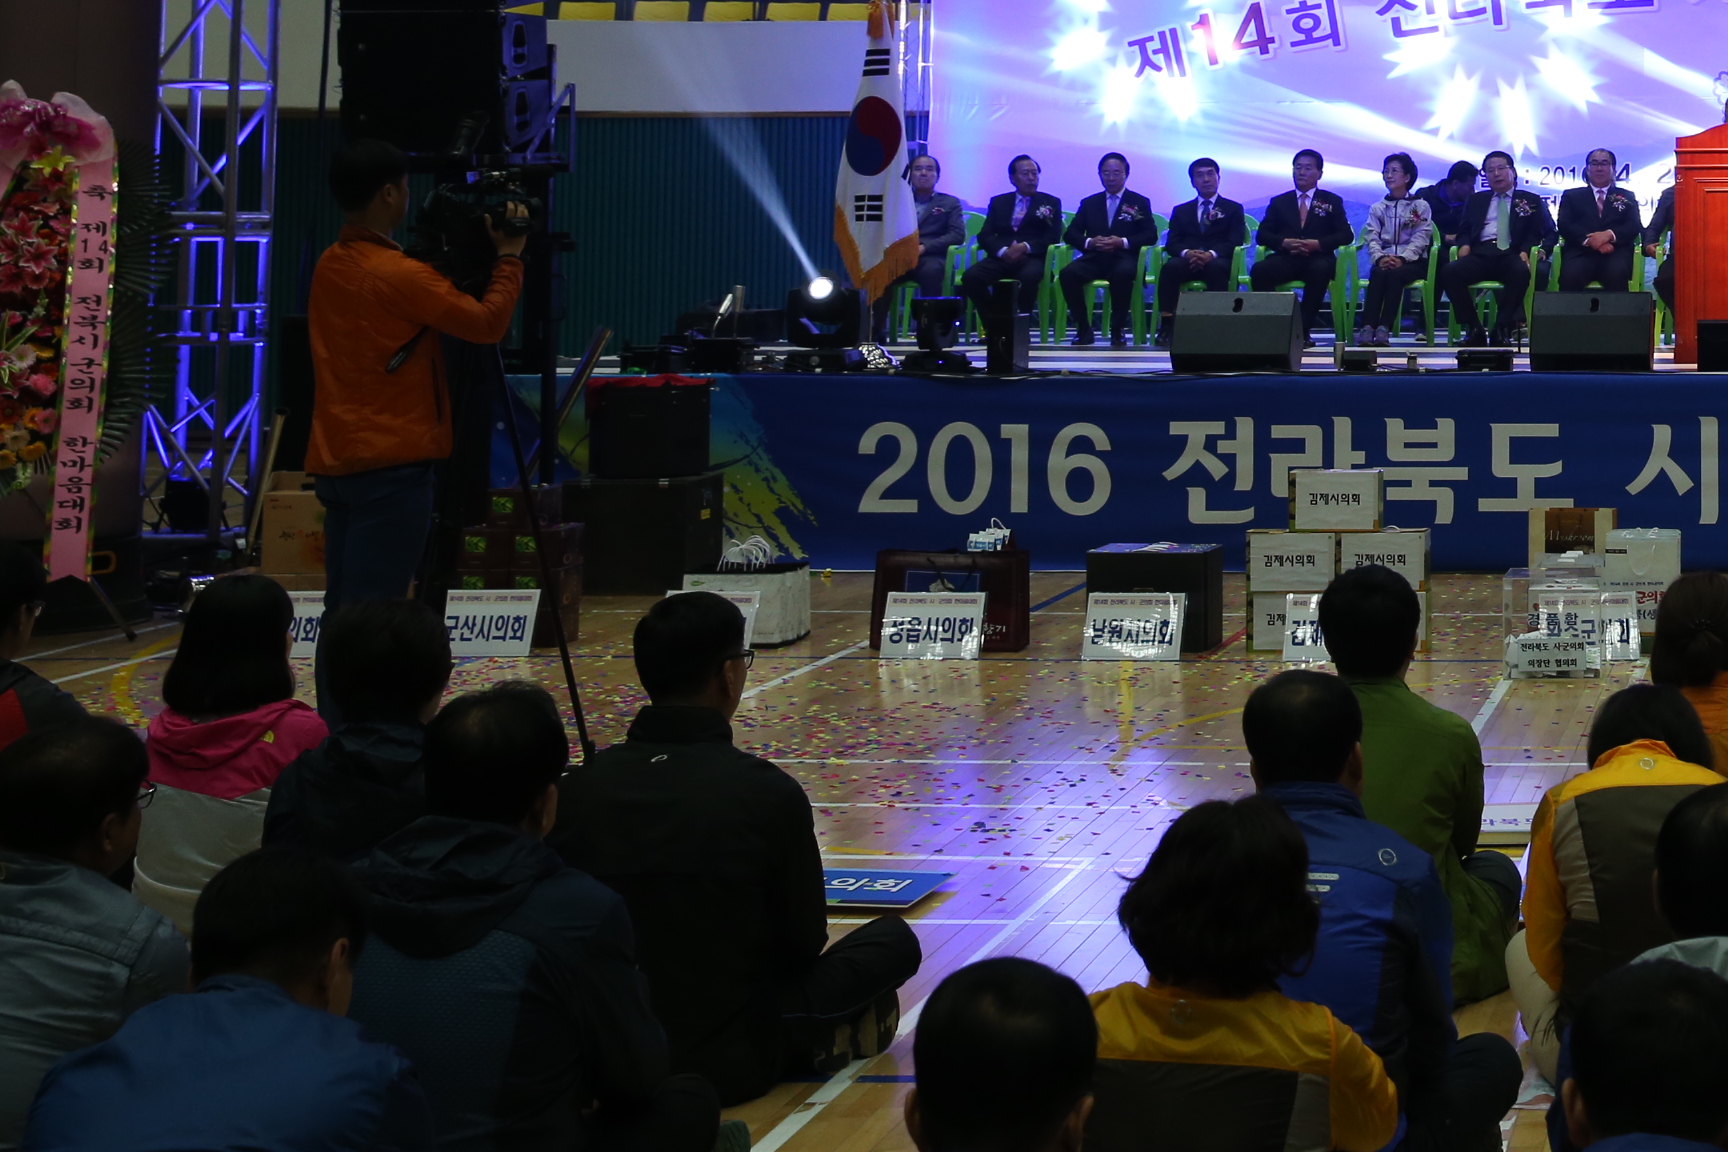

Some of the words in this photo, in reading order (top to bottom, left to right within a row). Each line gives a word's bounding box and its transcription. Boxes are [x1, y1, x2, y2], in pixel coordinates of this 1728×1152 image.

[82, 184, 112, 201] 축
[77, 221, 109, 274] 제14회
[858, 421, 1111, 515] 2016
[1163, 417, 1574, 525] 전라북도
[54, 435, 95, 534] 한마음대회
[1309, 493, 1361, 505] 김제시의회
[1263, 554, 1315, 567] 김제시의회
[1354, 553, 1406, 566] 김제시의회
[445, 615, 528, 642] 군산시의회
[1091, 618, 1173, 645] 남원시의회
[1520, 642, 1549, 652] 전라북도
[1528, 658, 1550, 668] 의장단
[1555, 658, 1577, 667] 협의회
